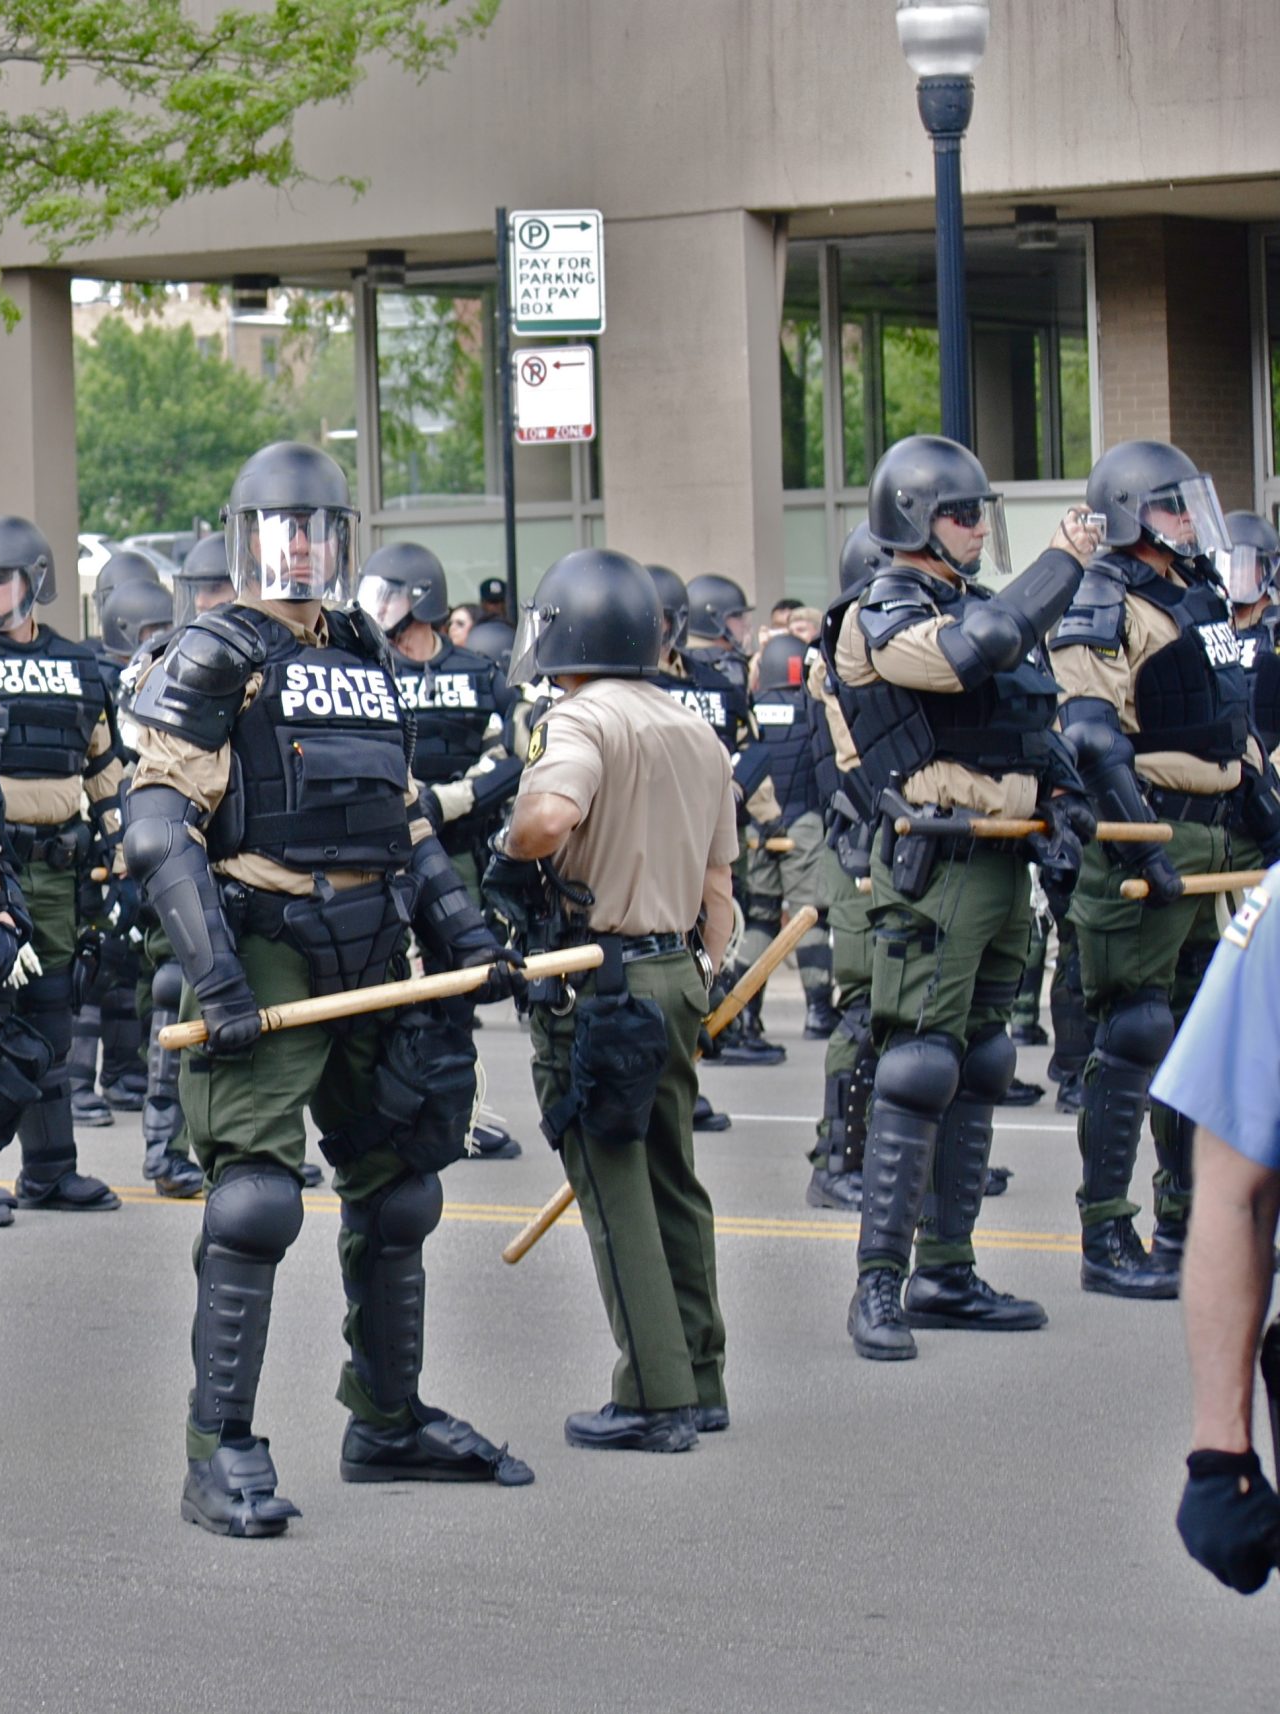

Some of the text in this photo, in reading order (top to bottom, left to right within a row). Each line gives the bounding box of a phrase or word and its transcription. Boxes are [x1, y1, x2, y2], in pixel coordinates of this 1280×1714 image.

[519, 257, 591, 270] PAY FOR
[519, 272, 596, 285] PARKING
[521, 287, 580, 299] AT PAY
[520, 303, 554, 315] BOX
[521, 425, 584, 440] TOW ZONE
[286, 664, 388, 696] STATE
[281, 688, 398, 722] POLICE
[398, 690, 477, 709] OLICE
